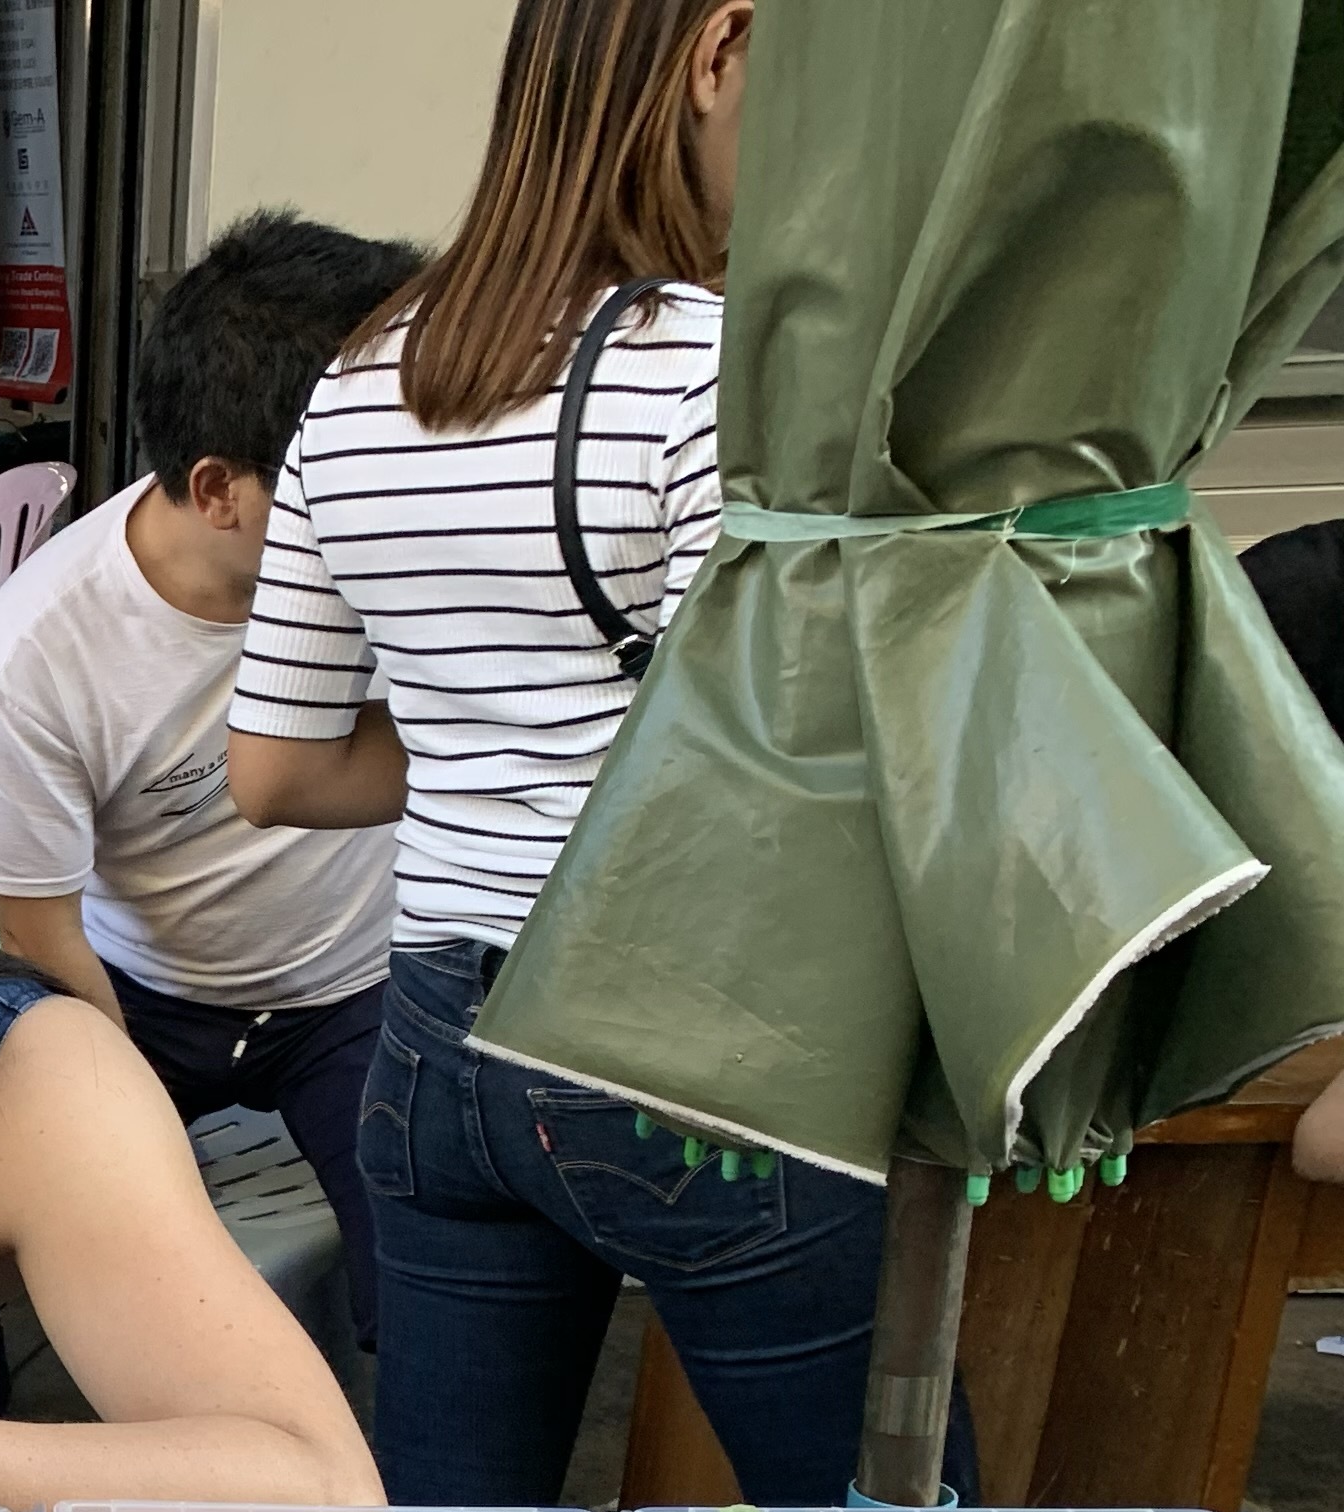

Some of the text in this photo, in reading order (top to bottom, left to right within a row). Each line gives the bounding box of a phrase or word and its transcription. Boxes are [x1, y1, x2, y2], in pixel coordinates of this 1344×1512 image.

[11, 108, 45, 127] Gem-A
[169, 765, 206, 783] many
[208, 761, 216, 769] a
